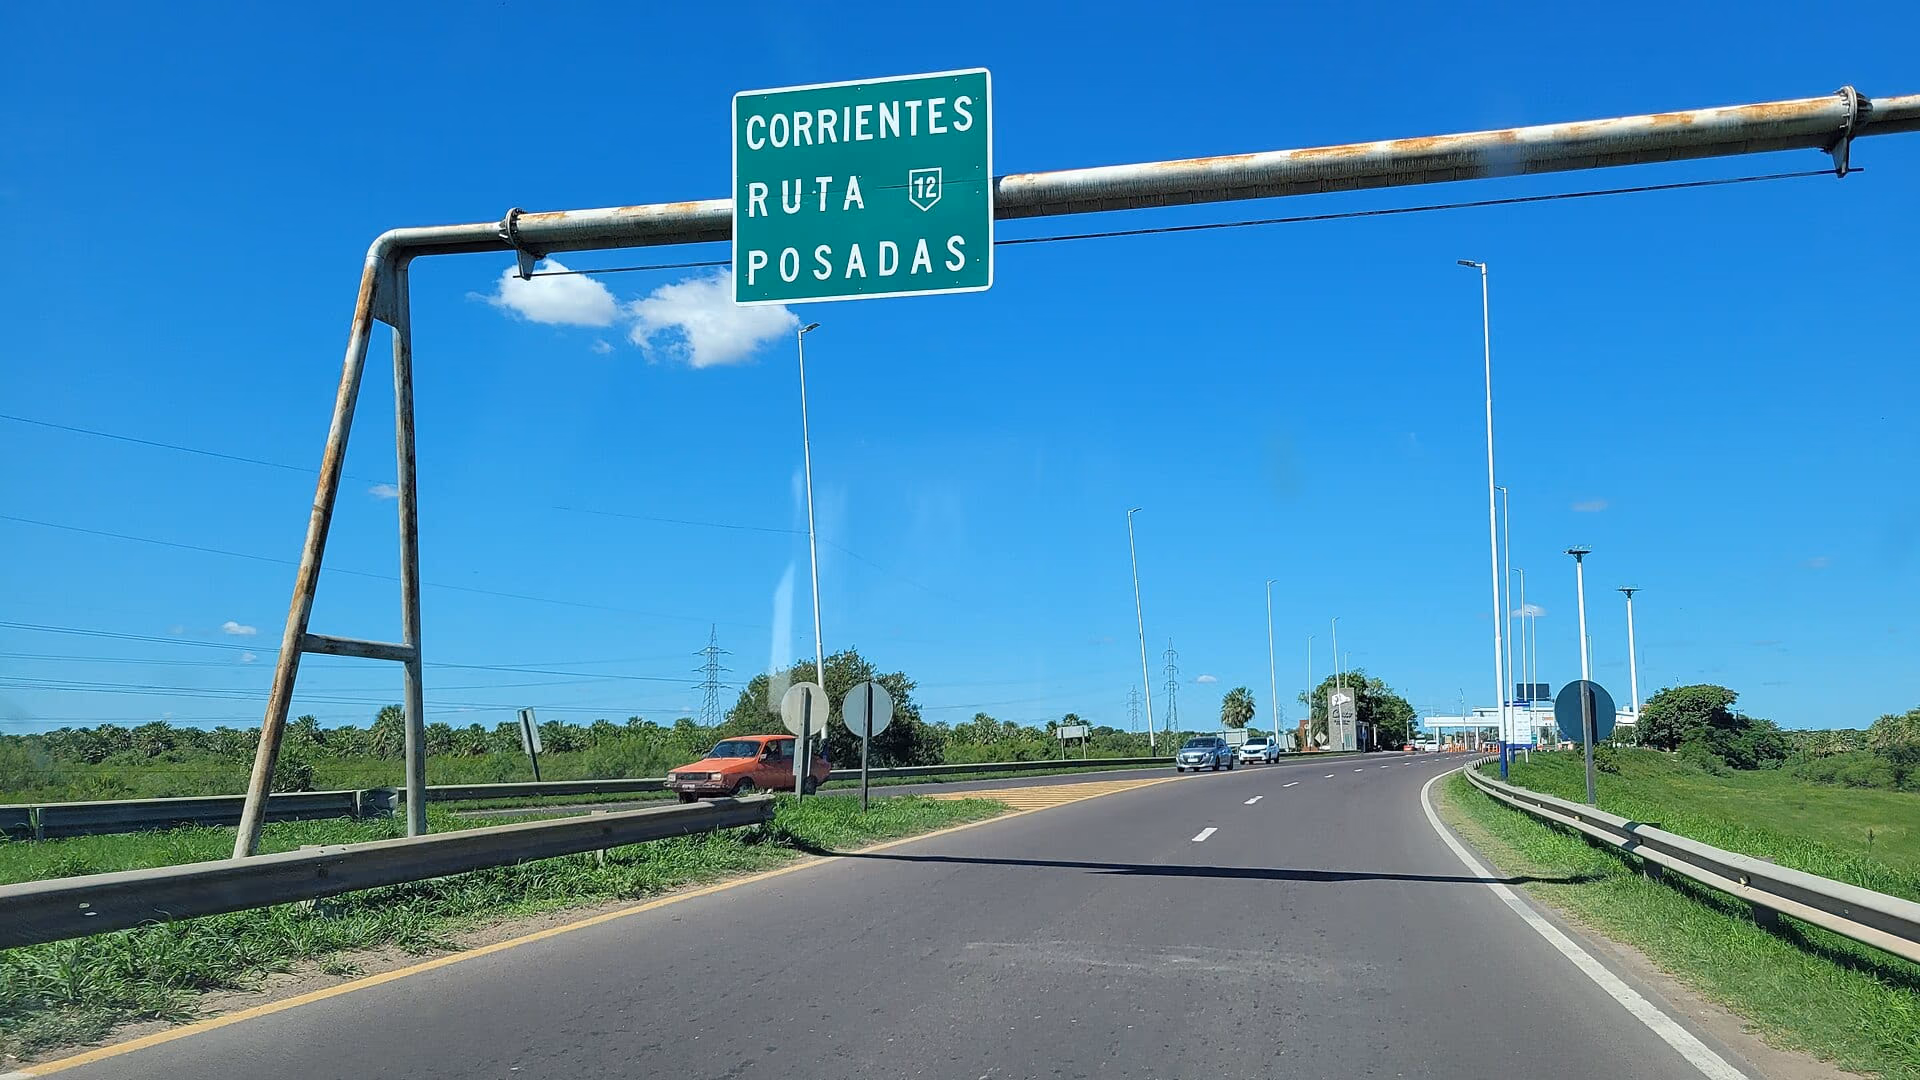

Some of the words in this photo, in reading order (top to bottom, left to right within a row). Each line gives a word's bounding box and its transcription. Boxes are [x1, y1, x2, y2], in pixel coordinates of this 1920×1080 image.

[746, 95, 973, 150] CORRIENTES
[748, 175, 865, 218] RUTA
[914, 176, 937, 199] 12
[748, 235, 966, 286] POSADAS
